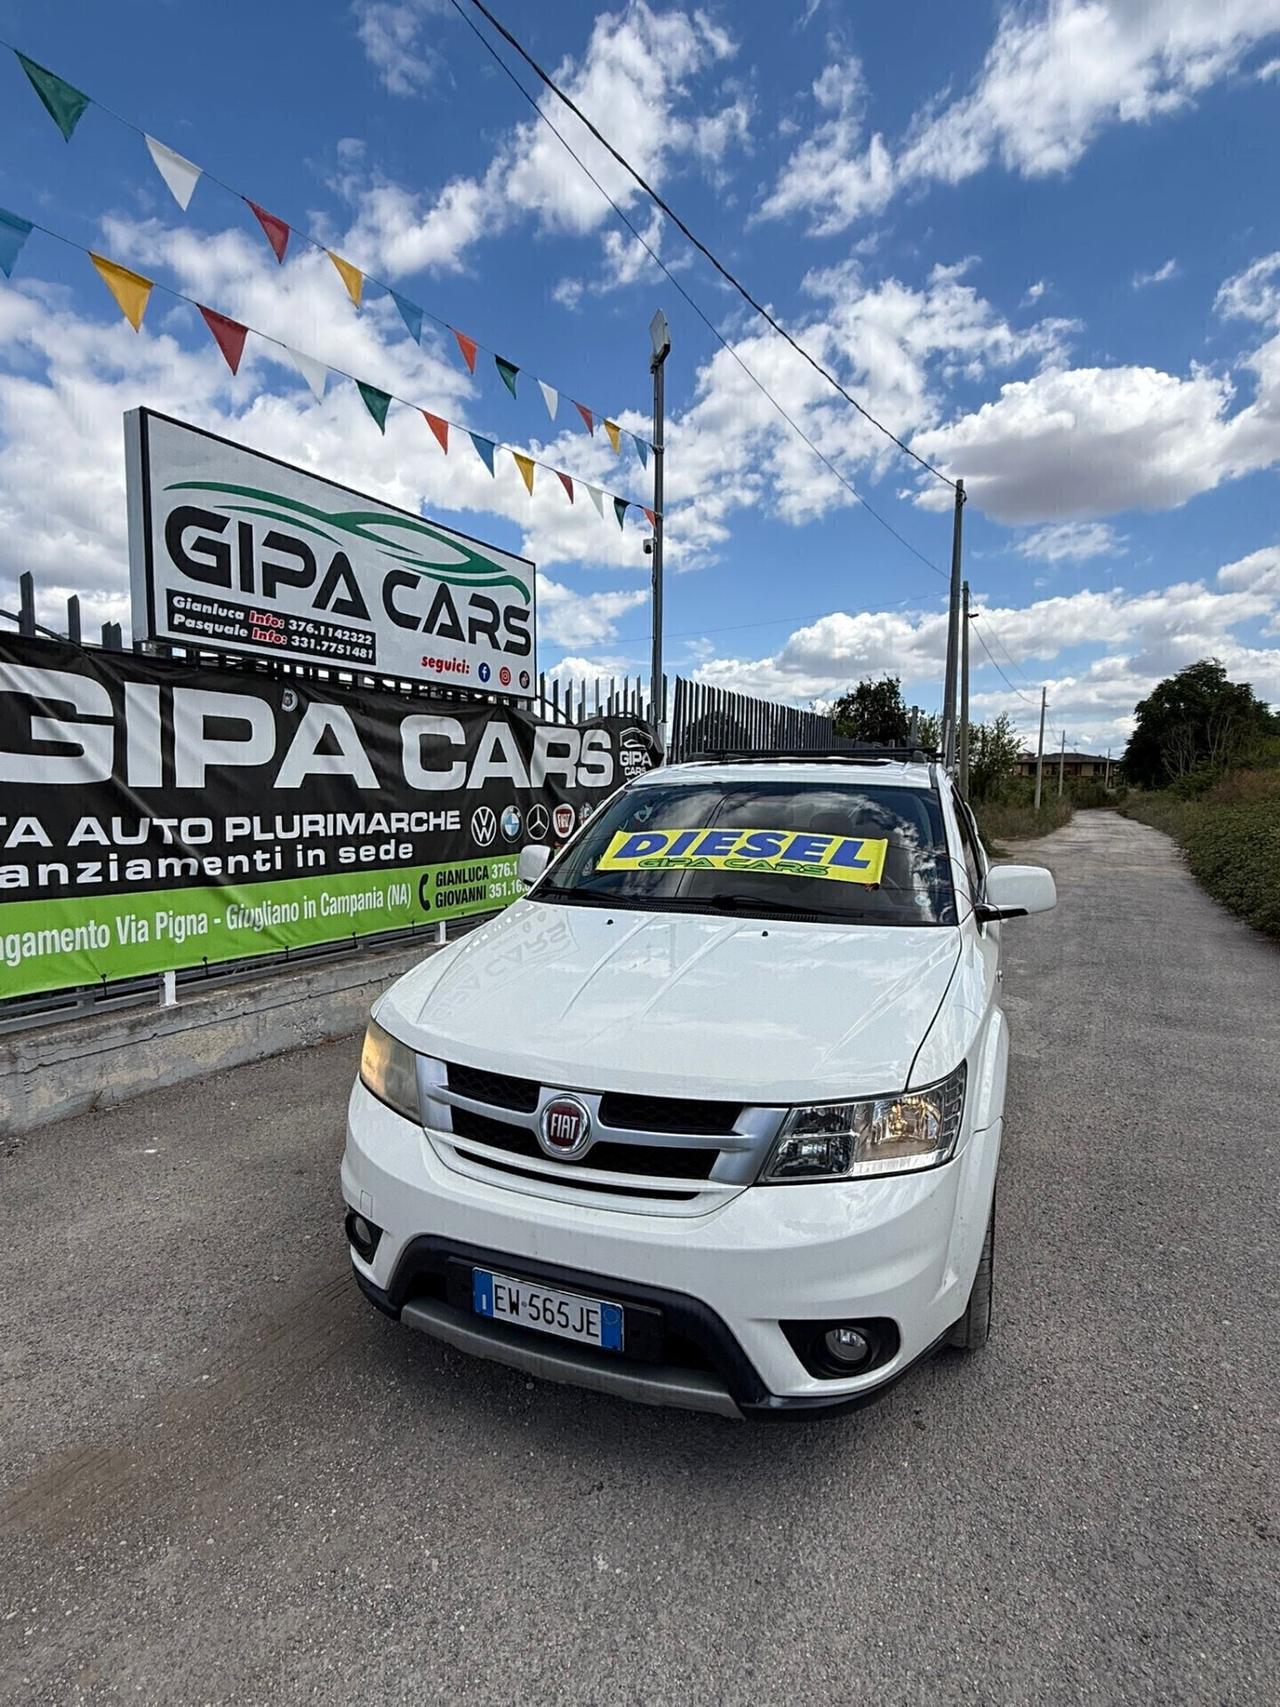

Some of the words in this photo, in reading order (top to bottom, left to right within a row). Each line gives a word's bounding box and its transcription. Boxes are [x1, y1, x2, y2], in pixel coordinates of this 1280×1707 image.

[165, 506, 371, 621] GIPA
[382, 569, 531, 657] CARS
[172, 595, 245, 620] Gianluca
[250, 610, 285, 629] Info:
[288, 619, 373, 645] 376.1142322
[173, 613, 248, 637] Pasquale
[252, 627, 288, 645] Info:
[291, 635, 373, 659] 331.7751481
[421, 656, 470, 674] seguici:
[0, 662, 381, 789] GIPA
[400, 714, 614, 791] CARS
[620, 751, 652, 767] GIPA
[624, 767, 647, 776] CARS
[0, 816, 53, 848] A
[67, 816, 213, 846] AUTO
[227, 811, 460, 841] PLURIMARCHE
[0, 846, 281, 888] anziamenti
[297, 845, 325, 868] in
[339, 839, 413, 864] sede
[613, 831, 873, 868] DIESEL
[638, 857, 716, 869] GIPA
[724, 858, 833, 876] CARS
[435, 865, 489, 887] GIANLUCA
[491, 861, 517, 879] 376.1
[116, 914, 149, 944] Via
[156, 911, 208, 944] Pigna
[226, 902, 299, 932] Giugliano
[304, 896, 316, 919] in
[320, 886, 383, 917] Campania
[387, 884, 412, 911] (NA)
[435, 885, 486, 908] GIOVANNI
[550, 1113, 579, 1139] FIAT
